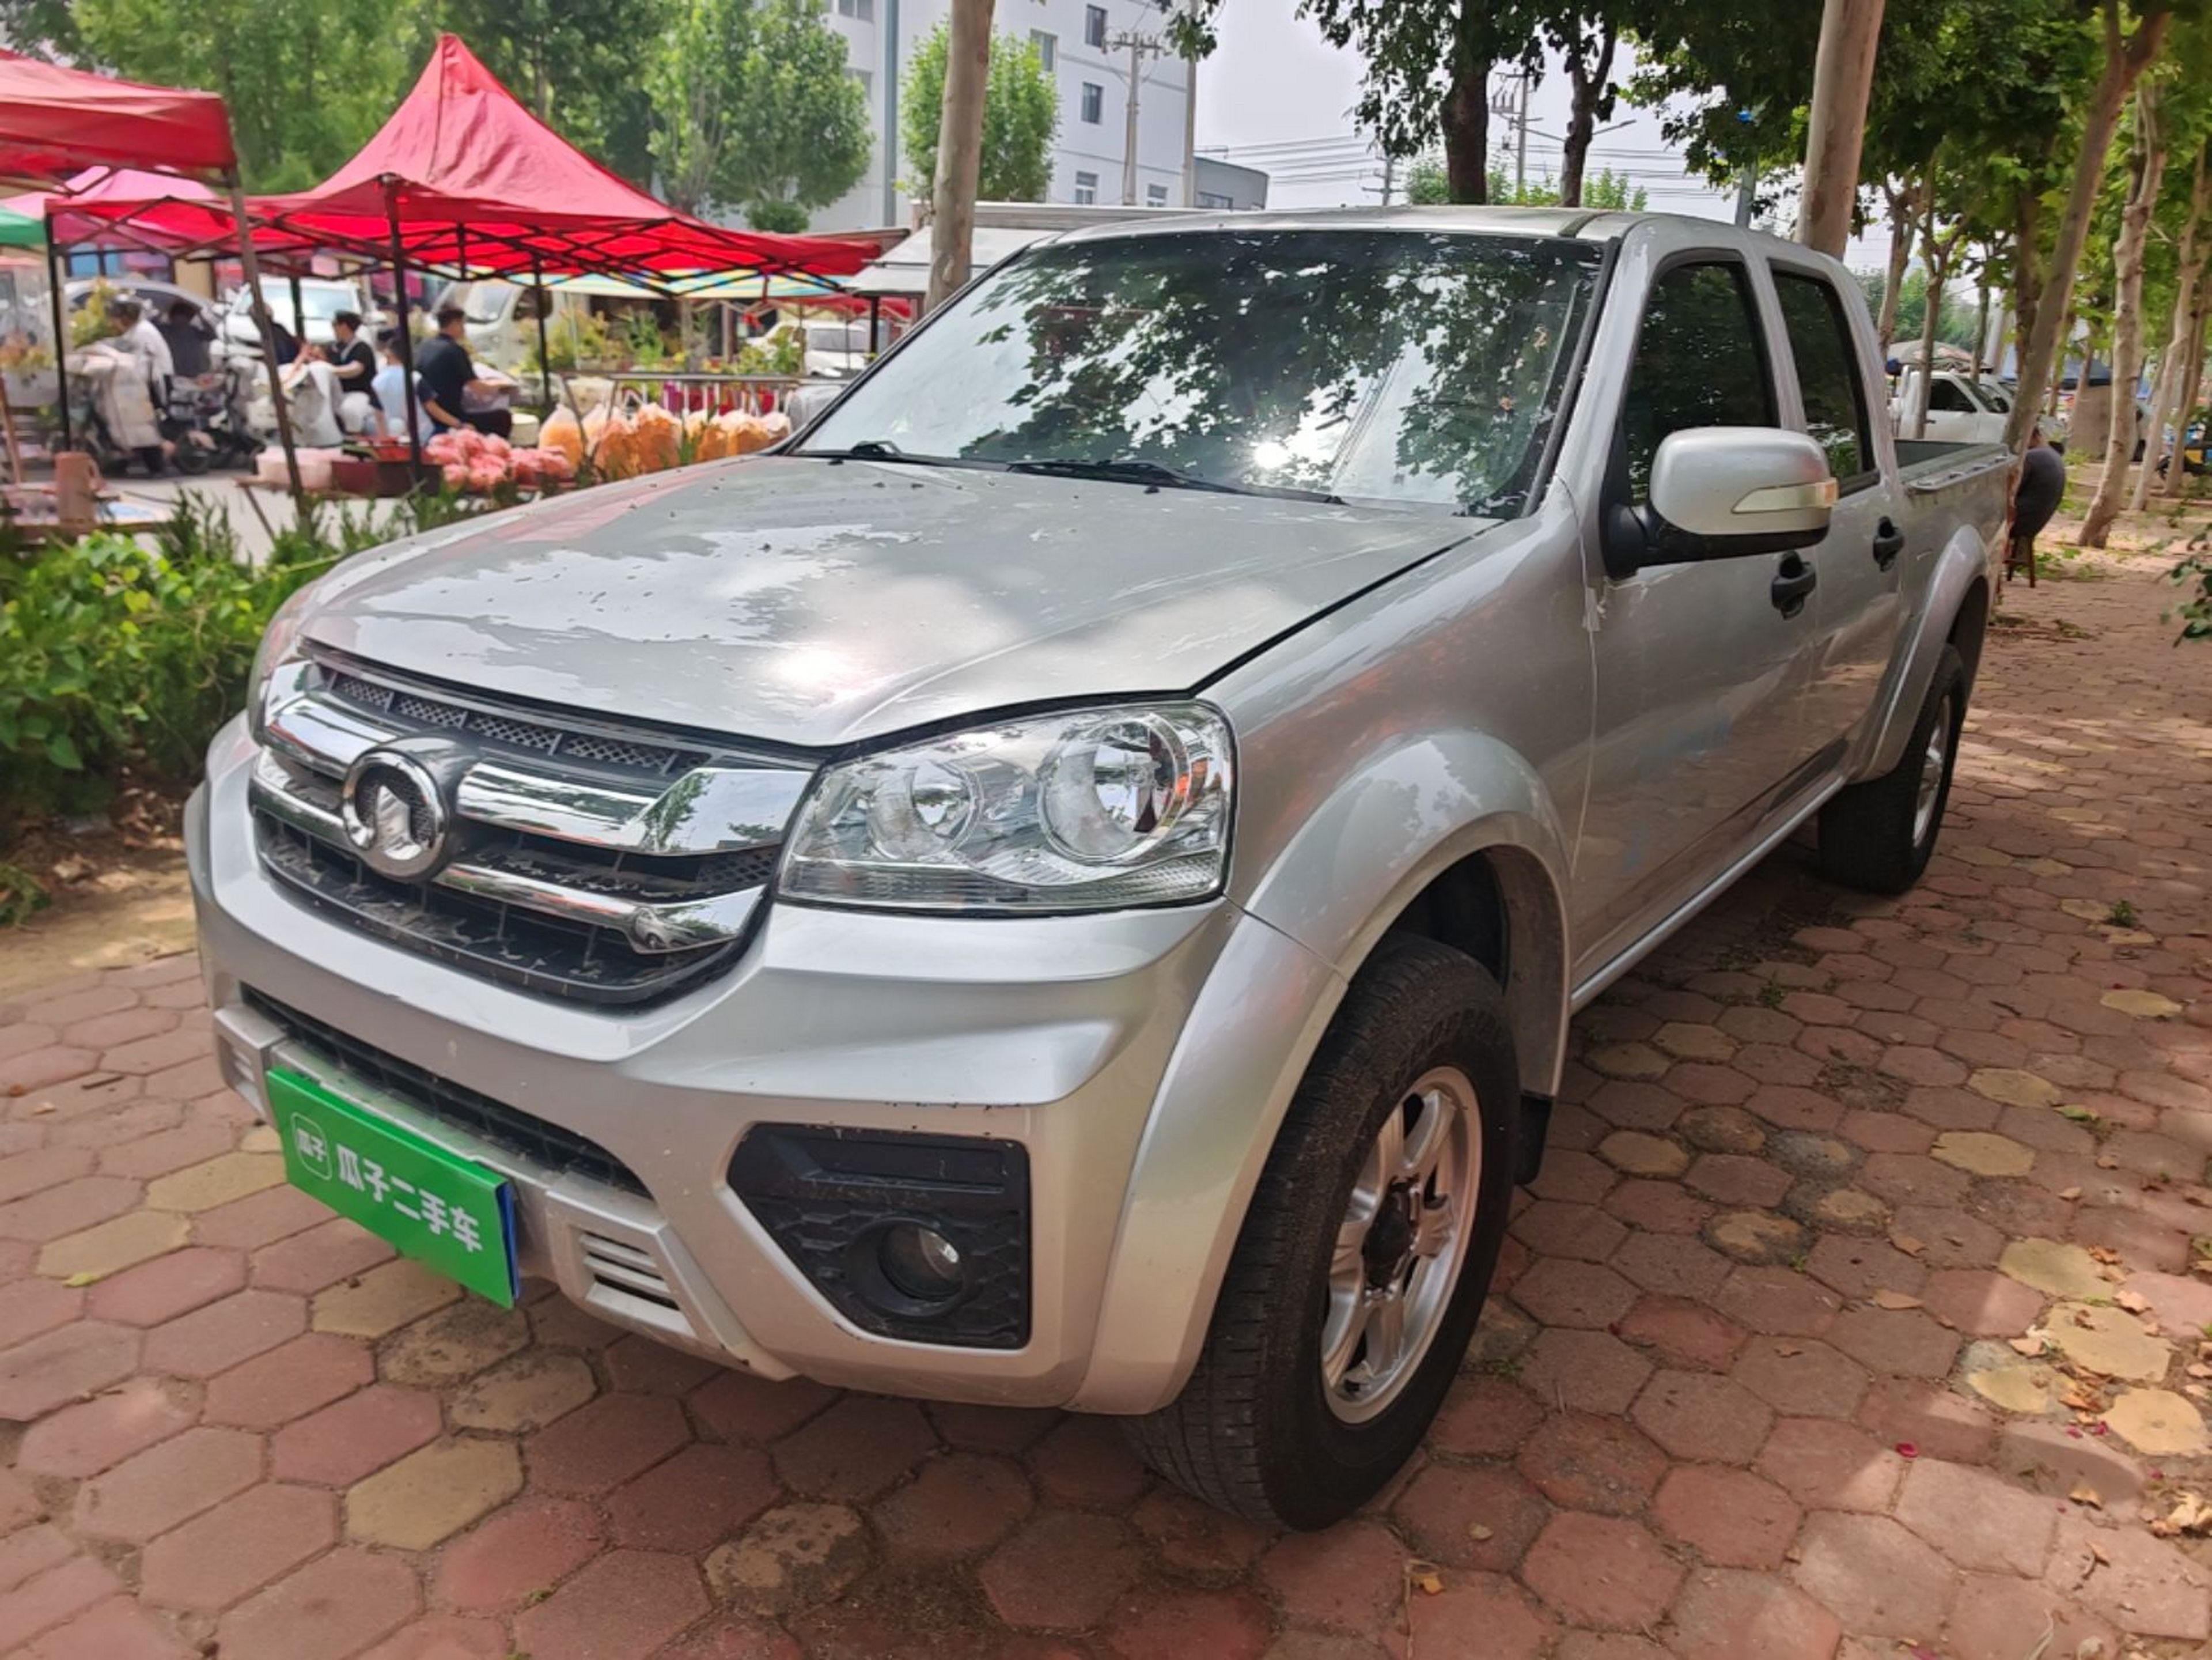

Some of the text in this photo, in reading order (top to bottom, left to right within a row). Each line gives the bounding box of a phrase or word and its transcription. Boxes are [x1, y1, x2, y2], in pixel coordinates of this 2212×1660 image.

[336, 1143, 483, 1253] 瓜子二手车
